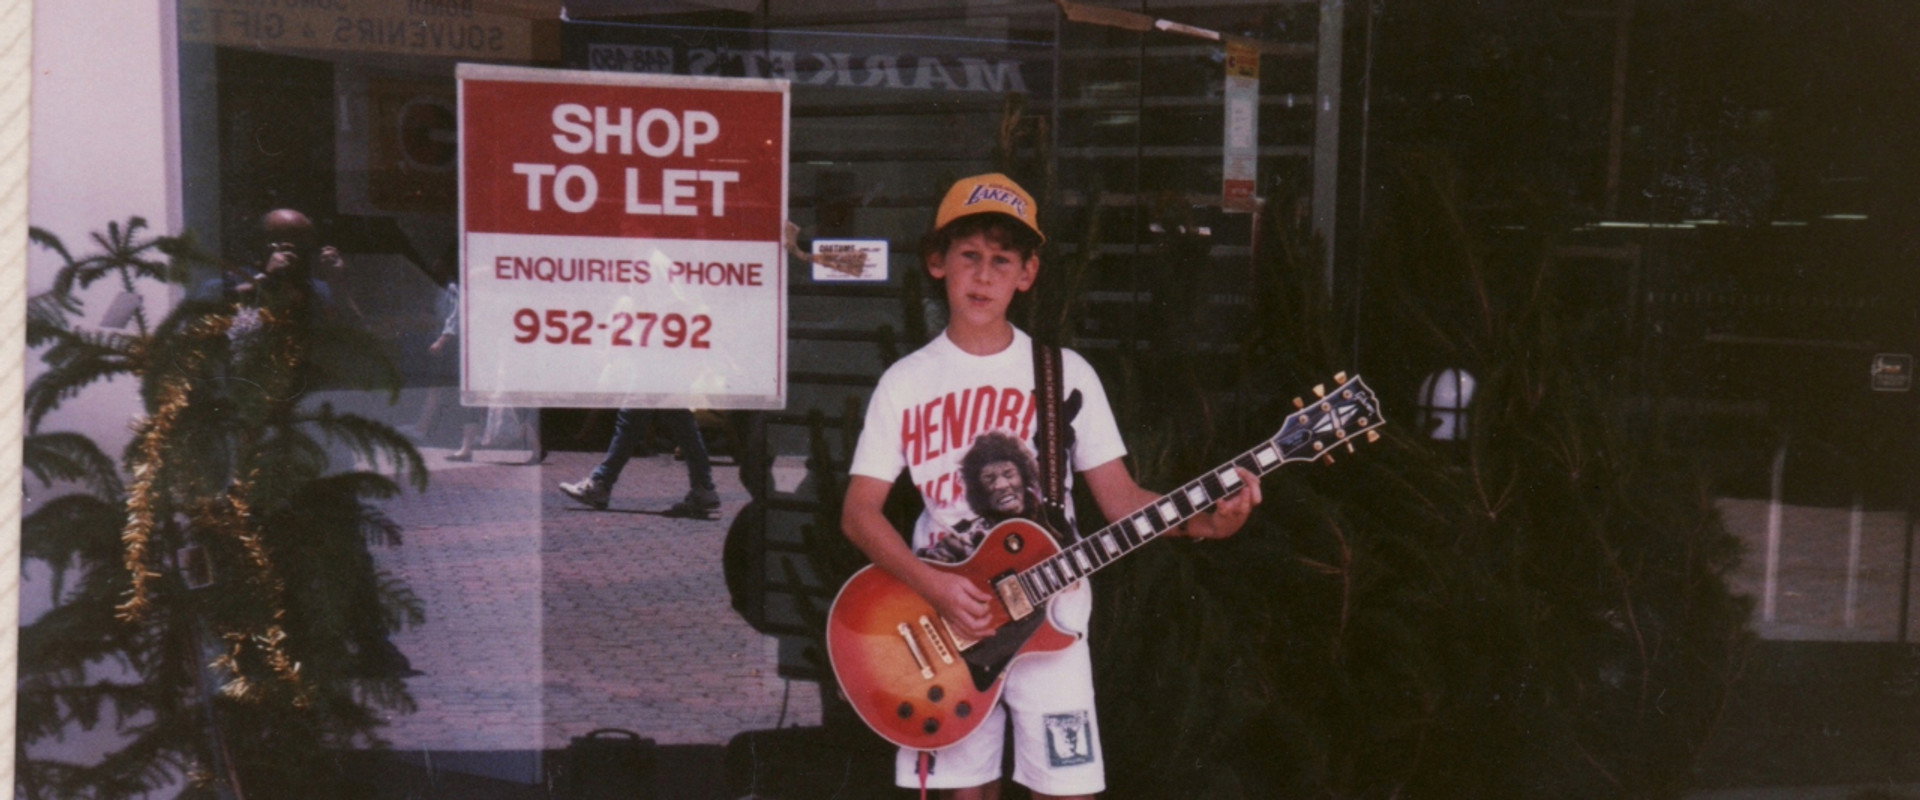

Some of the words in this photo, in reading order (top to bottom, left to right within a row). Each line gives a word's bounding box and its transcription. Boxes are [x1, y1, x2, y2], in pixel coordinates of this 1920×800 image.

[552, 103, 719, 158] SHOP
[513, 162, 598, 214] TO
[625, 167, 739, 217] LET
[495, 256, 651, 284] ENQUIRIES
[668, 262, 763, 287] PHONE
[513, 307, 713, 349] 952-2792
